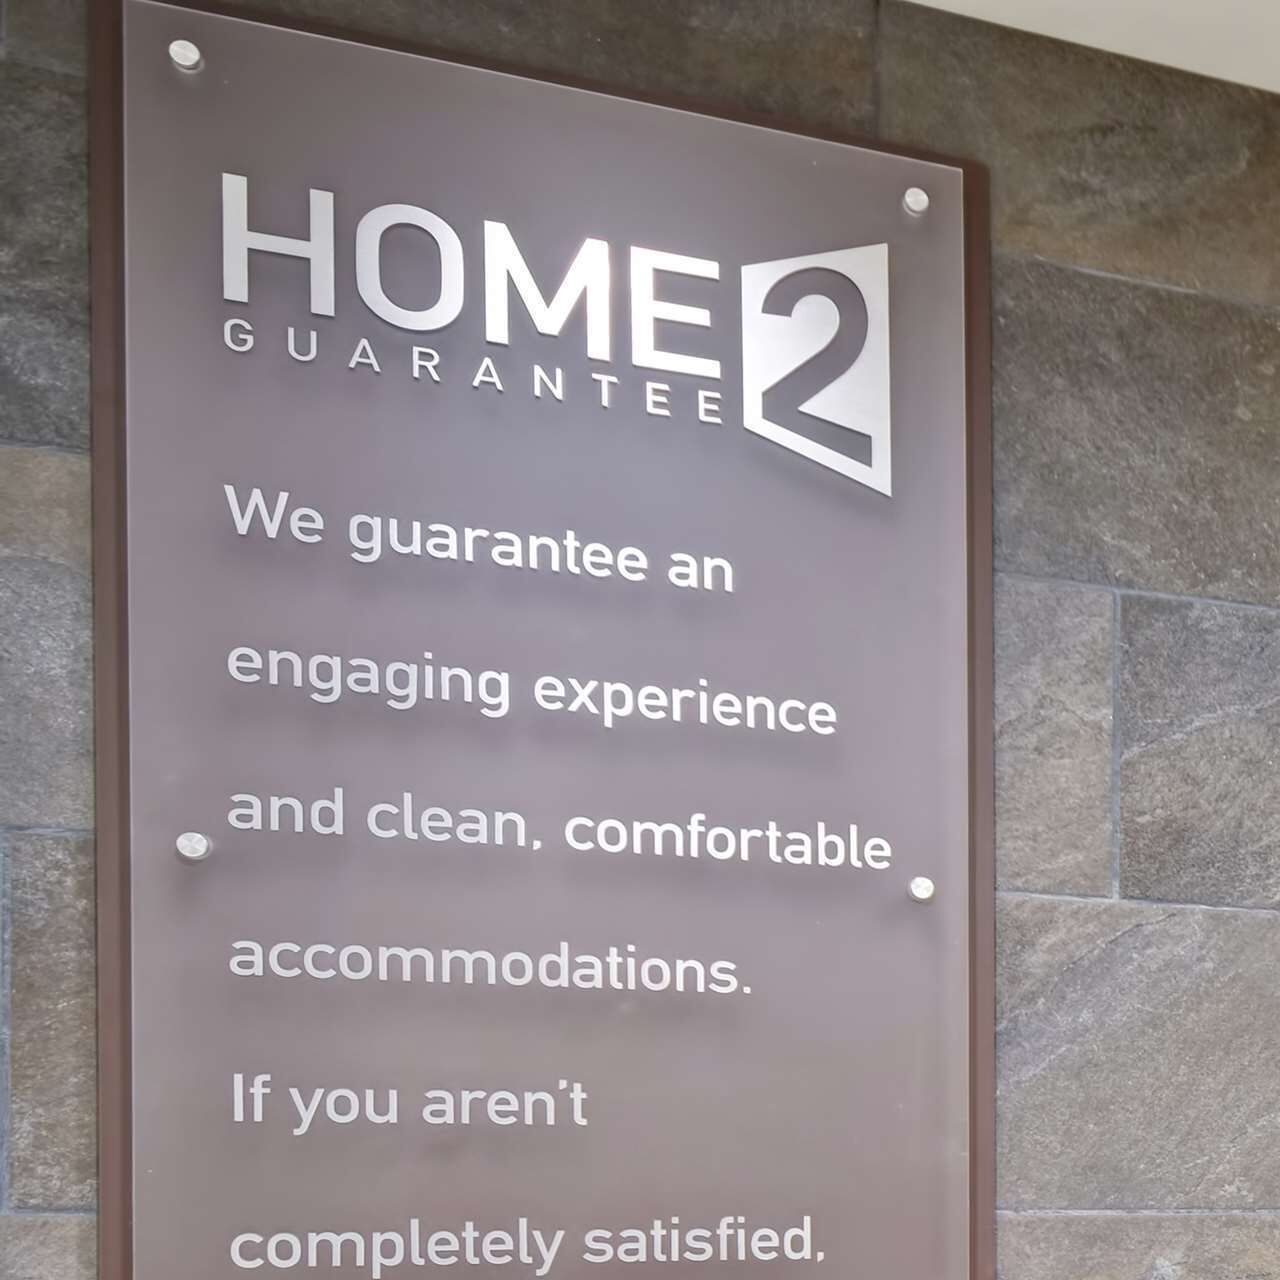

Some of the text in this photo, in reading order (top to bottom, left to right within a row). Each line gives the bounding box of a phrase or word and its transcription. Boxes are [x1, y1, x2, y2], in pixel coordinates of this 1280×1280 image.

[221, 173, 876, 471] HOME 2
[223, 317, 723, 425] GUARANTEE
[222, 484, 734, 593] We guarantee an
[227, 646, 838, 736] engaging experience
[226, 787, 893, 871] and clean, comfortable
[229, 939, 753, 995] accommodations.
[232, 1072, 589, 1136] If you aren't
[229, 1214, 826, 1280] completely satisfied,
